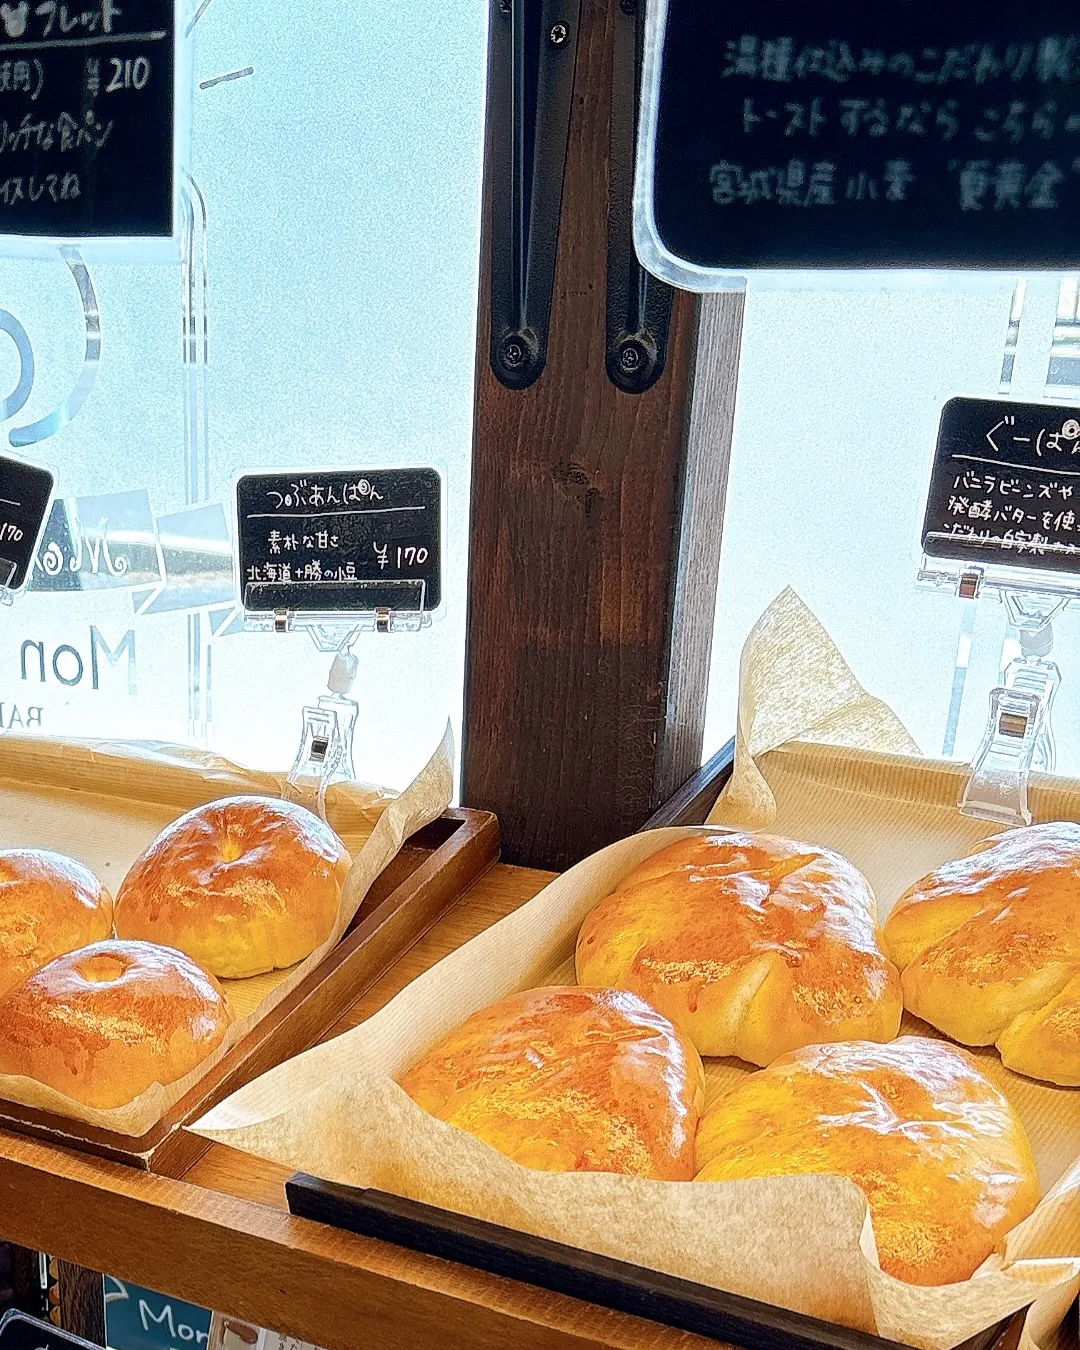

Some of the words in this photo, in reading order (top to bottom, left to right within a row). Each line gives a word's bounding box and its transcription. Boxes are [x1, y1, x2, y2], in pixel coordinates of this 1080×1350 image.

[87, 55, 150, 97] ¥210
[266, 479, 383, 509] つぶあんぱん
[953, 470, 1074, 501] バニラビーンズや
[947, 495, 1080, 532] 発酵バターを使
[268, 529, 340, 555] 素朴な甘さ
[246, 559, 358, 582] 北海道十勝の小豆
[373, 541, 429, 570] ¥170
